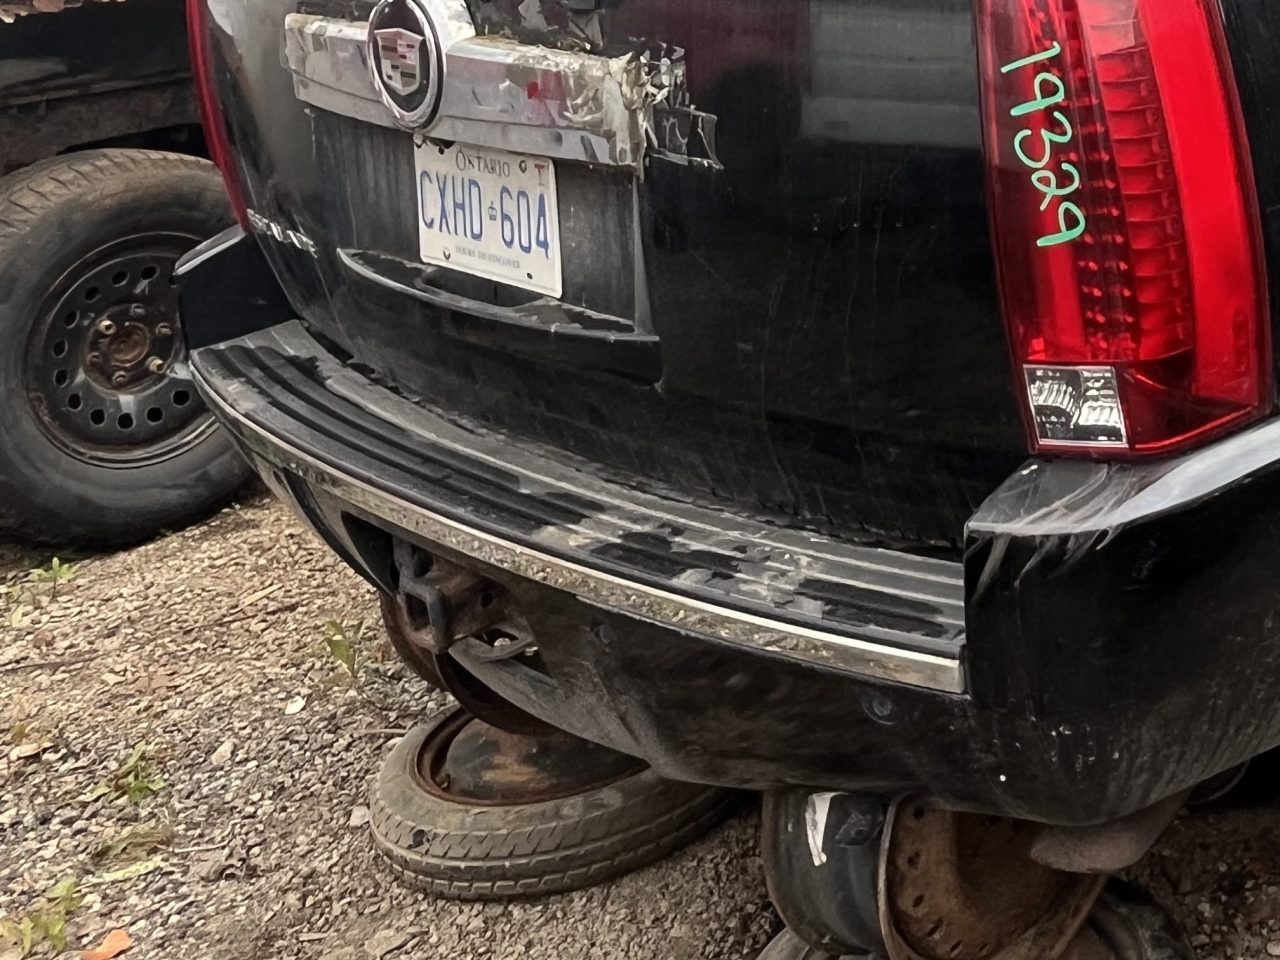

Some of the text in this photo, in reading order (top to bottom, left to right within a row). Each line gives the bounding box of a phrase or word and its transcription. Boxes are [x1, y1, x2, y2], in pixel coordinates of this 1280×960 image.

[420, 170, 550, 260] CXHD 604
[1000, 41, 1086, 247] 19329
